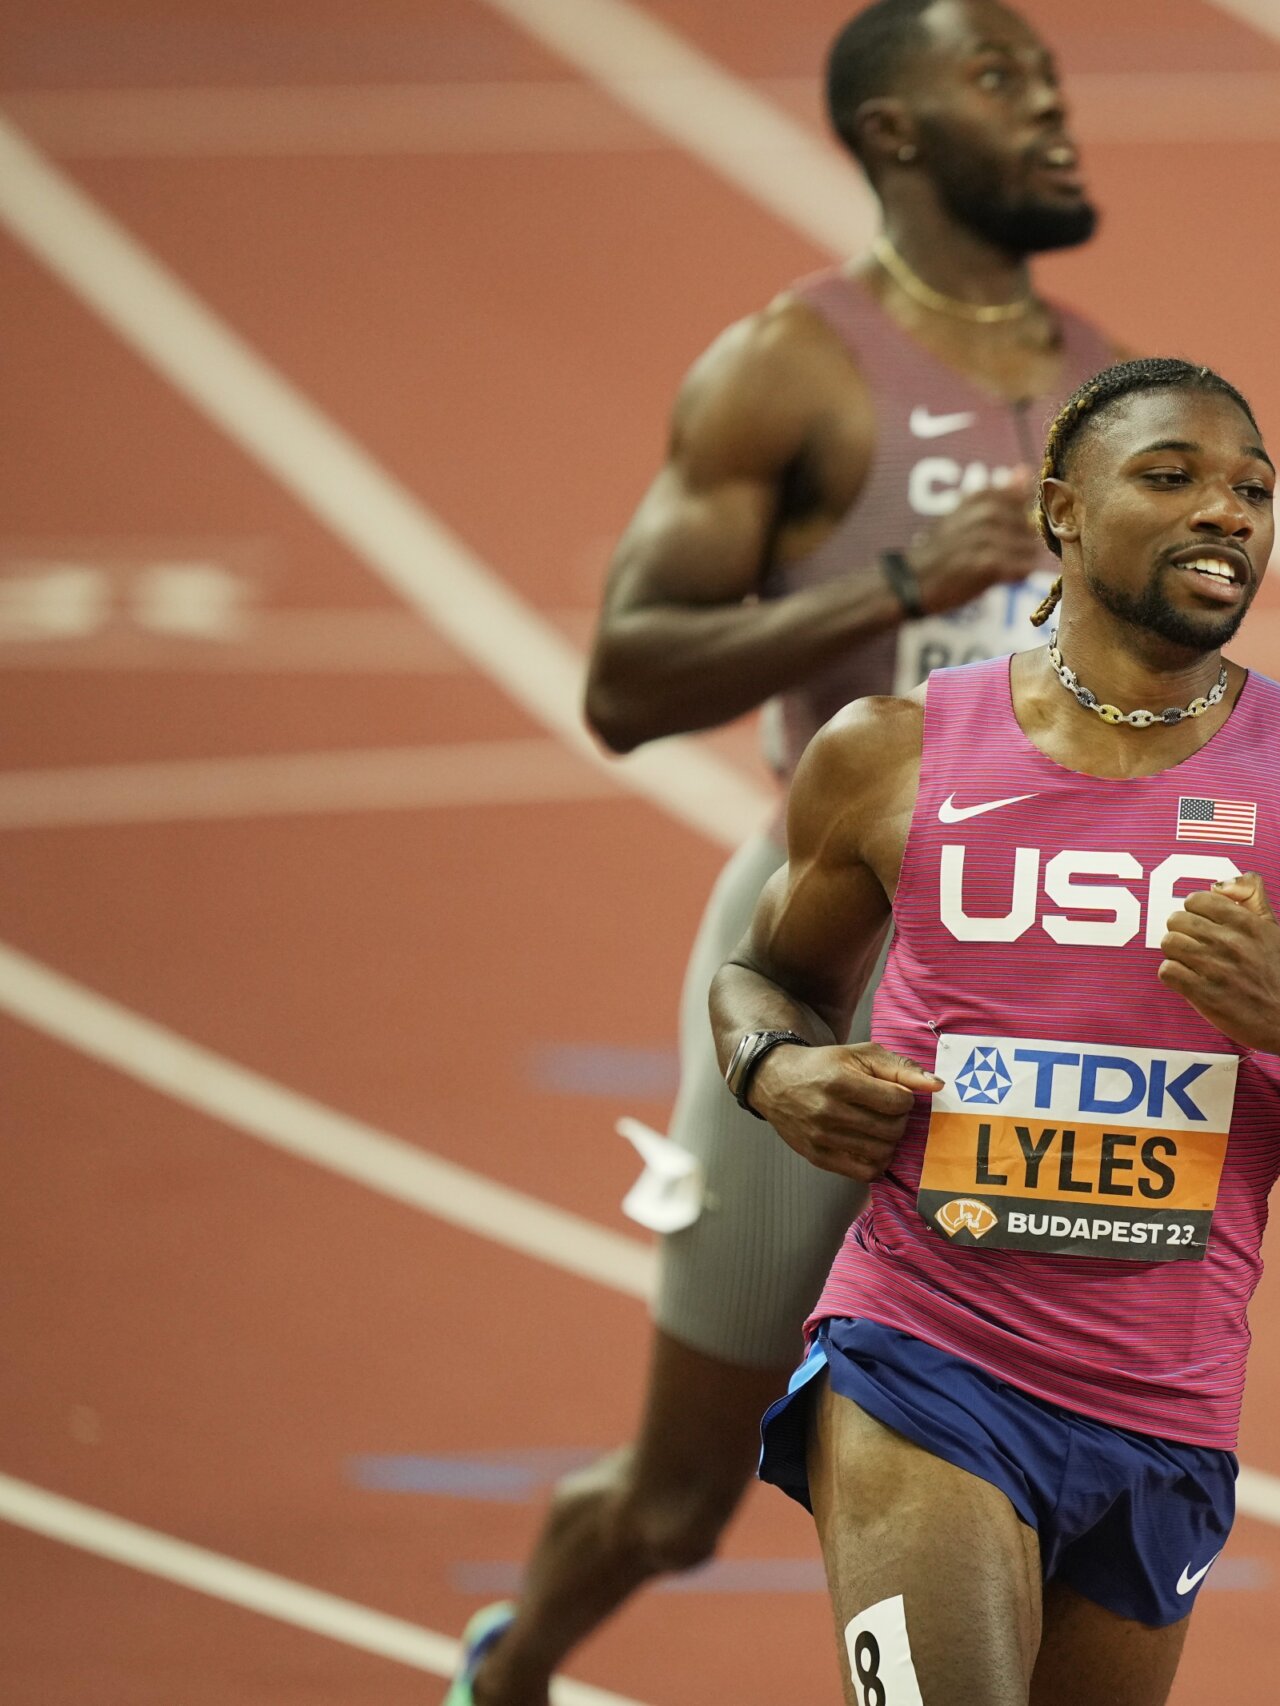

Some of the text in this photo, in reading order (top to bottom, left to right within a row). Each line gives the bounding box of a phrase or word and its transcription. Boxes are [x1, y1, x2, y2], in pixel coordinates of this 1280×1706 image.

[1014, 1048, 1213, 1122] TDK
[975, 1123, 1178, 1200] LYLES
[1007, 1211, 1164, 1245] BUDAPEST
[854, 1630, 886, 1706] 8
